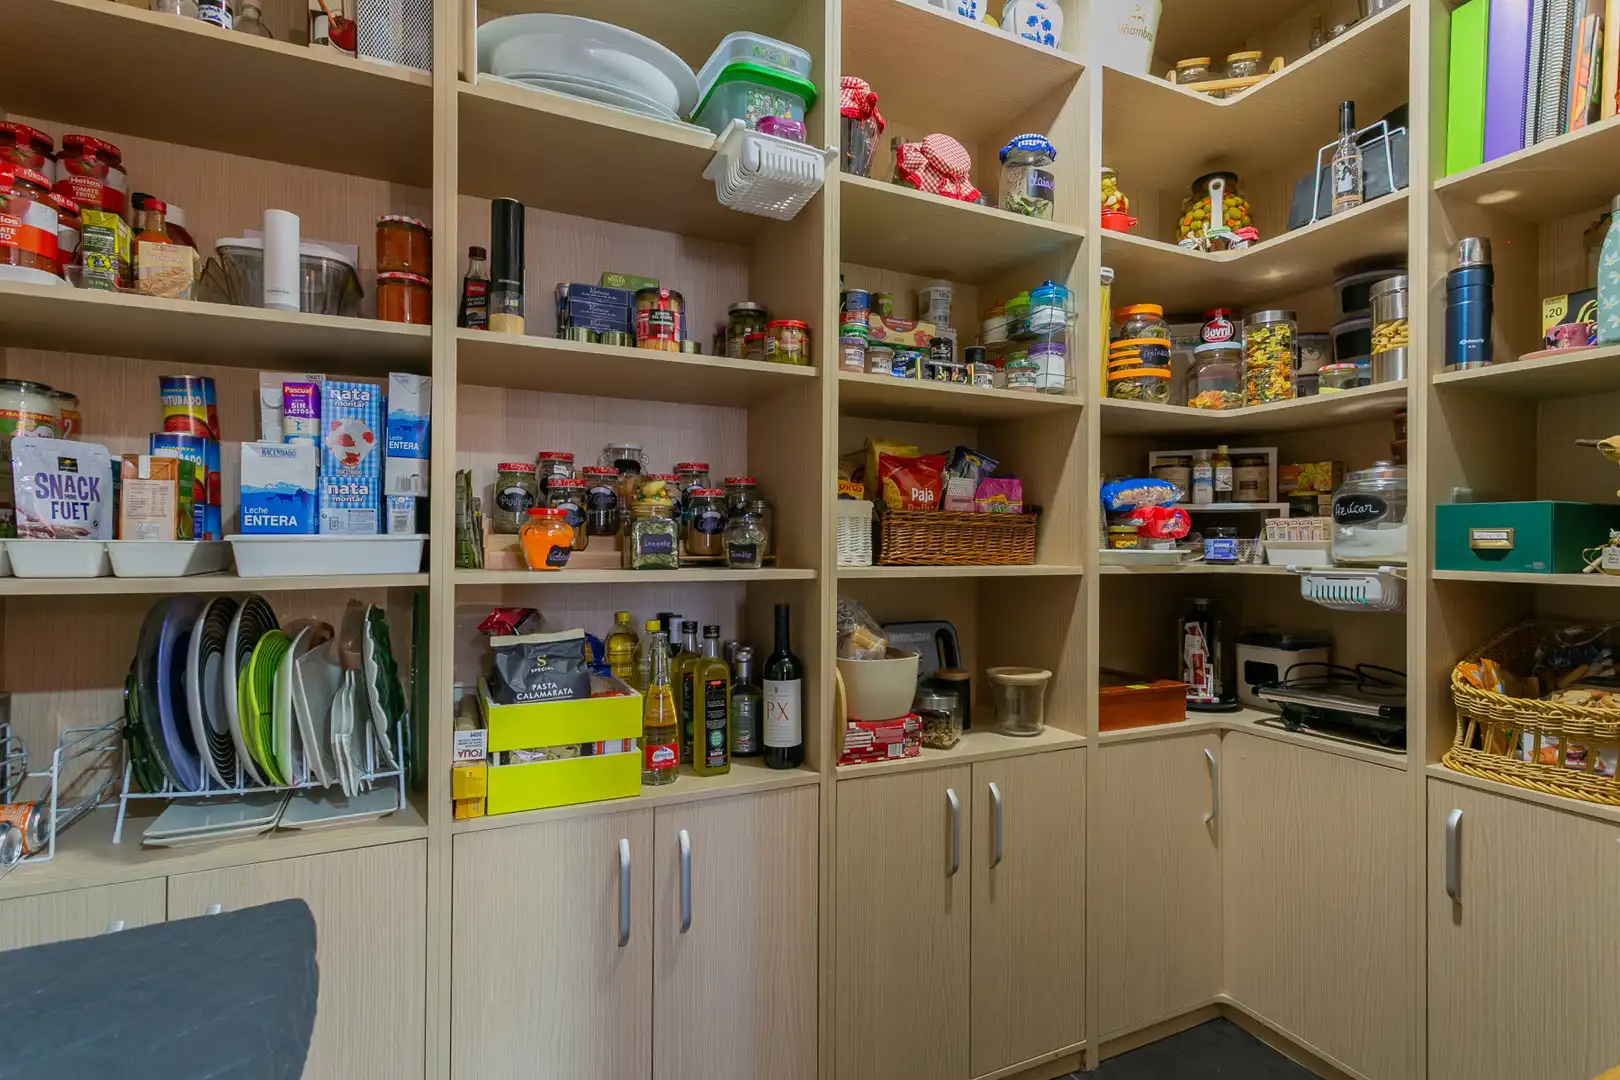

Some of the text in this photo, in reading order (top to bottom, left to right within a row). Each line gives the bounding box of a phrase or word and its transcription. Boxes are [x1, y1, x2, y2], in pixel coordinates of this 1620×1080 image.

[70, 176, 102, 187] Helios
[72, 185, 99, 194] TOMATE
[1545, 307, 1562, 319] x20
[1204, 324, 1231, 338] Bovril
[284, 386, 313, 395] Pascual
[329, 387, 371, 402] nata
[334, 400, 366, 408] montar
[389, 441, 420, 451] ENTERA
[260, 447, 297, 458] HACENDADO
[35, 472, 100, 502] SNACK
[327, 482, 370, 495] nata
[332, 495, 365, 503] montar
[911, 488, 934, 503] Paja
[51, 501, 90, 521] FUET
[244, 506, 269, 514] Leche
[1335, 501, 1379, 516] Azúcar
[244, 515, 298, 527] ENTERA
[536, 654, 548, 667] S
[531, 666, 555, 674] SPECIAL
[532, 682, 558, 691] PASTA
[516, 688, 574, 701] CALAMARATA
[766, 700, 790, 722] PX
[458, 749, 483, 758] FOLIA
